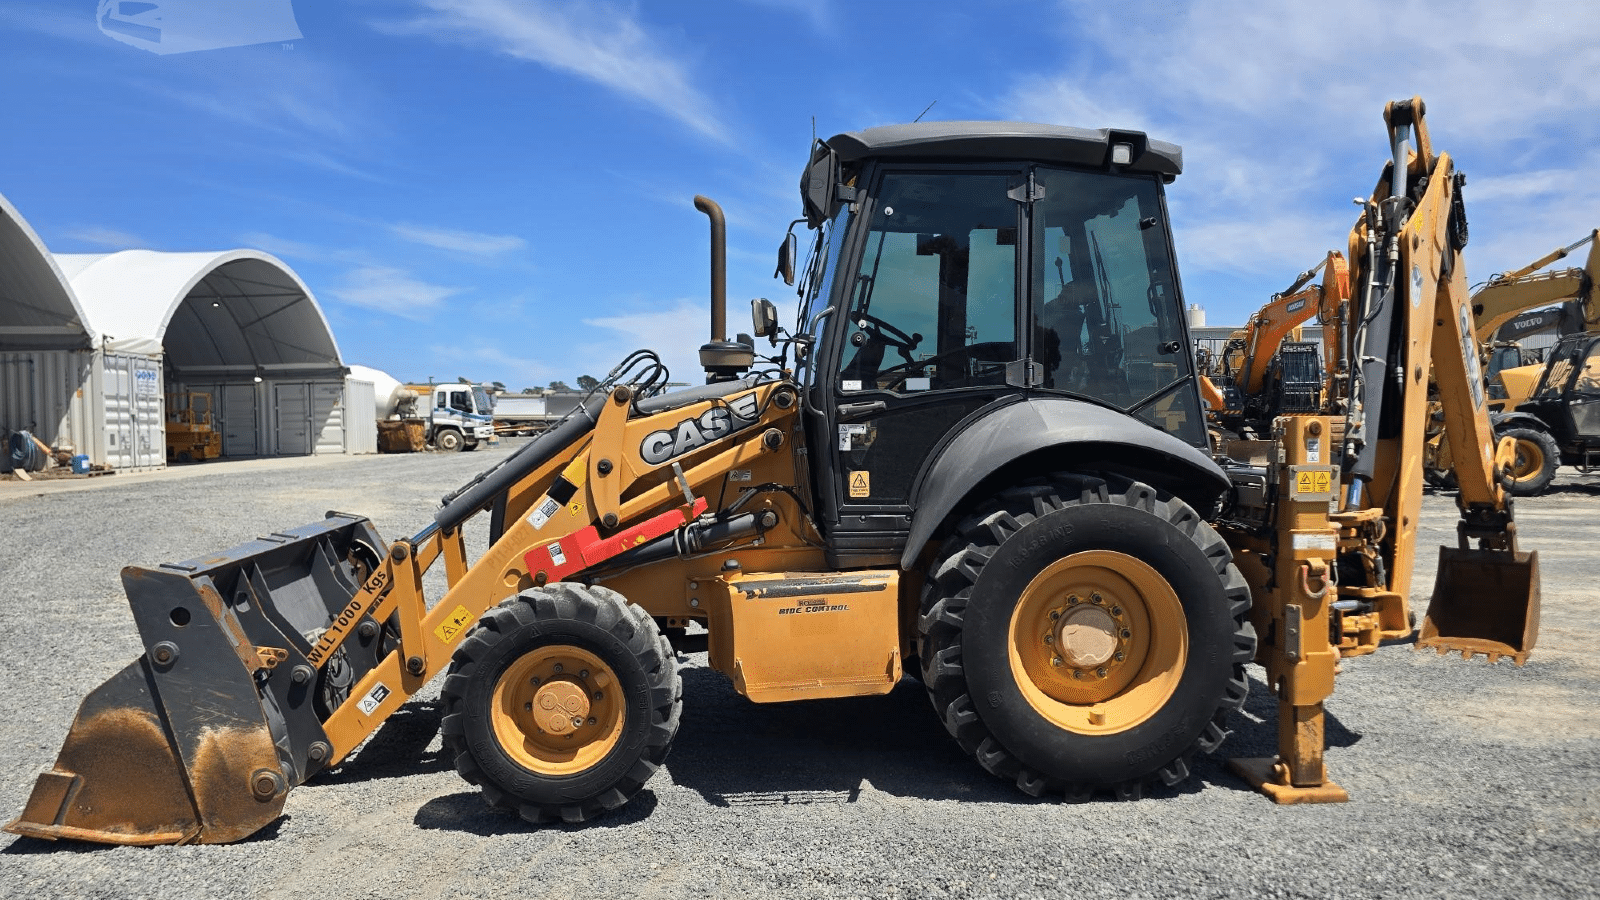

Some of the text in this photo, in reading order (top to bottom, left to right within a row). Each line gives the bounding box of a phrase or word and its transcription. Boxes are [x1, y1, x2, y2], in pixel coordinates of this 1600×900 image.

[1513, 317, 1542, 330] VOLVO
[641, 391, 758, 464] CASE
[308, 571, 386, 664] WLL 1000 Kgs
[779, 604, 850, 615] RIDE CONTROL
